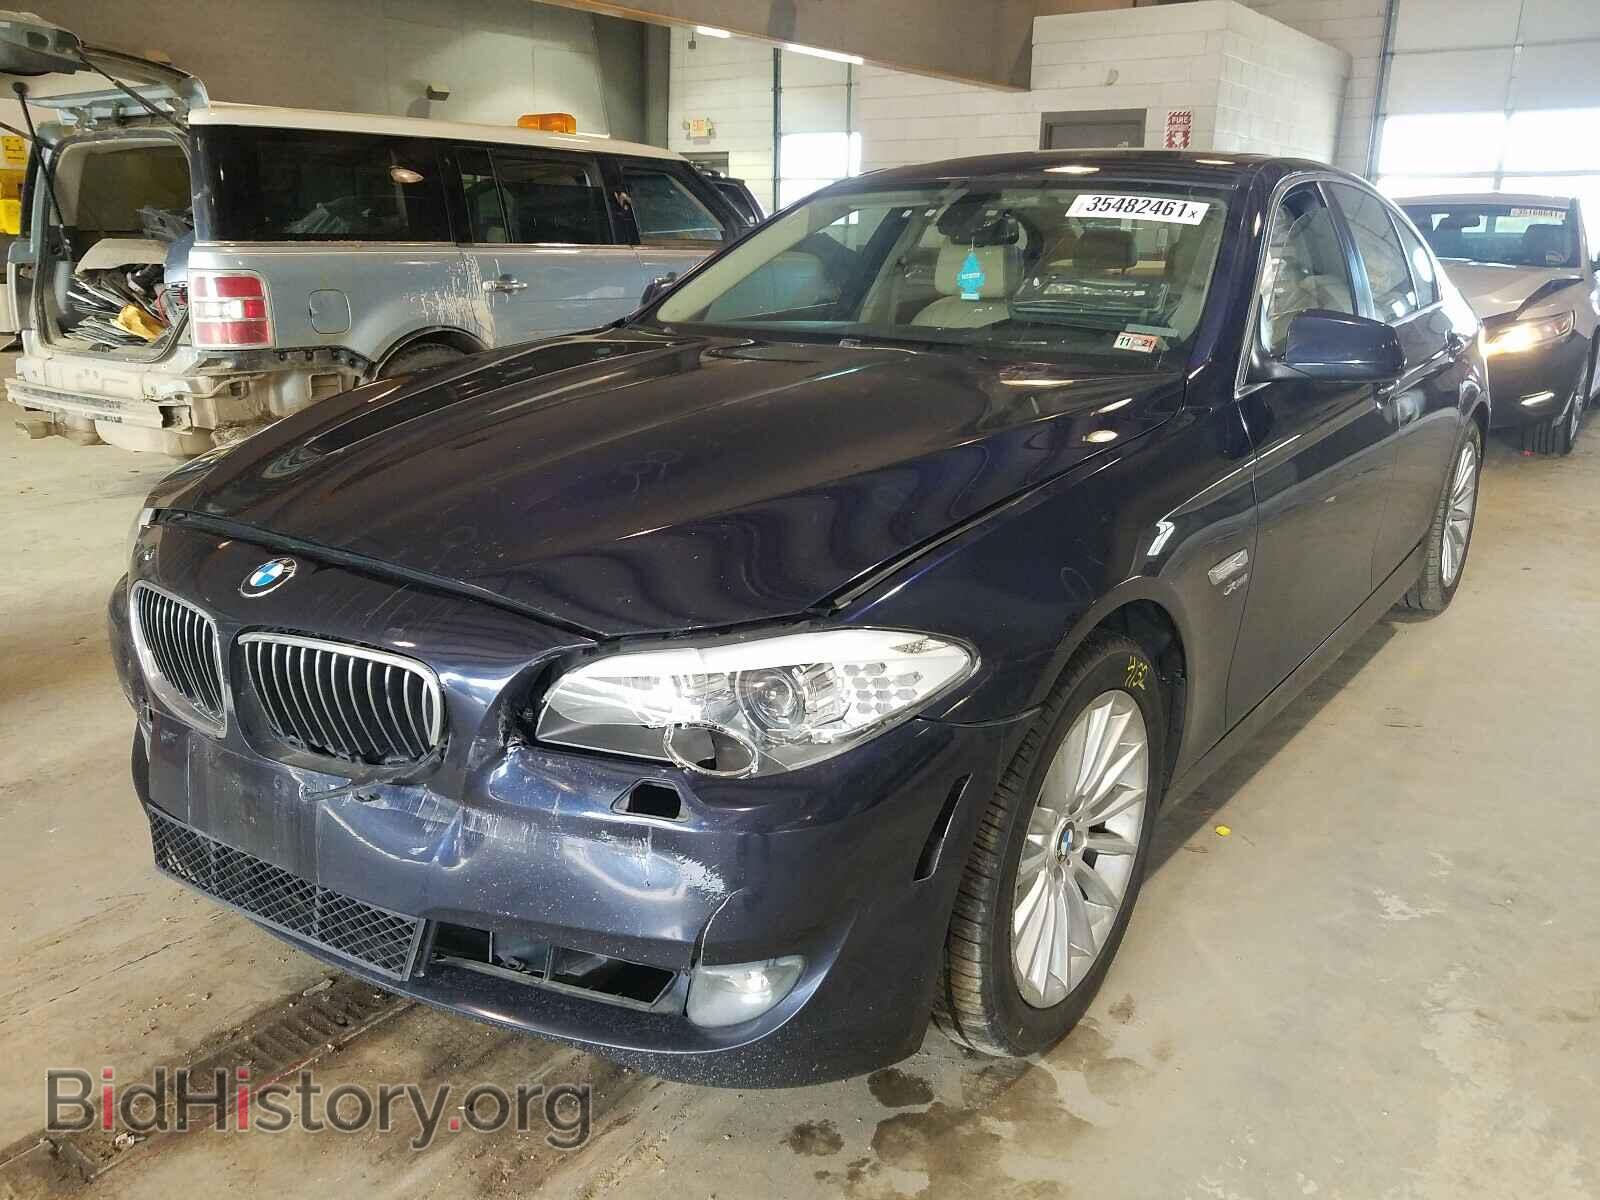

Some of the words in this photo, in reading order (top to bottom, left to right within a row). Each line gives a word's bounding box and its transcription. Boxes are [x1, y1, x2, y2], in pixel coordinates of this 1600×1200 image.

[1086, 196, 1188, 217] 35482461
[1120, 336, 1132, 346] 11
[1142, 339, 1153, 348] 21
